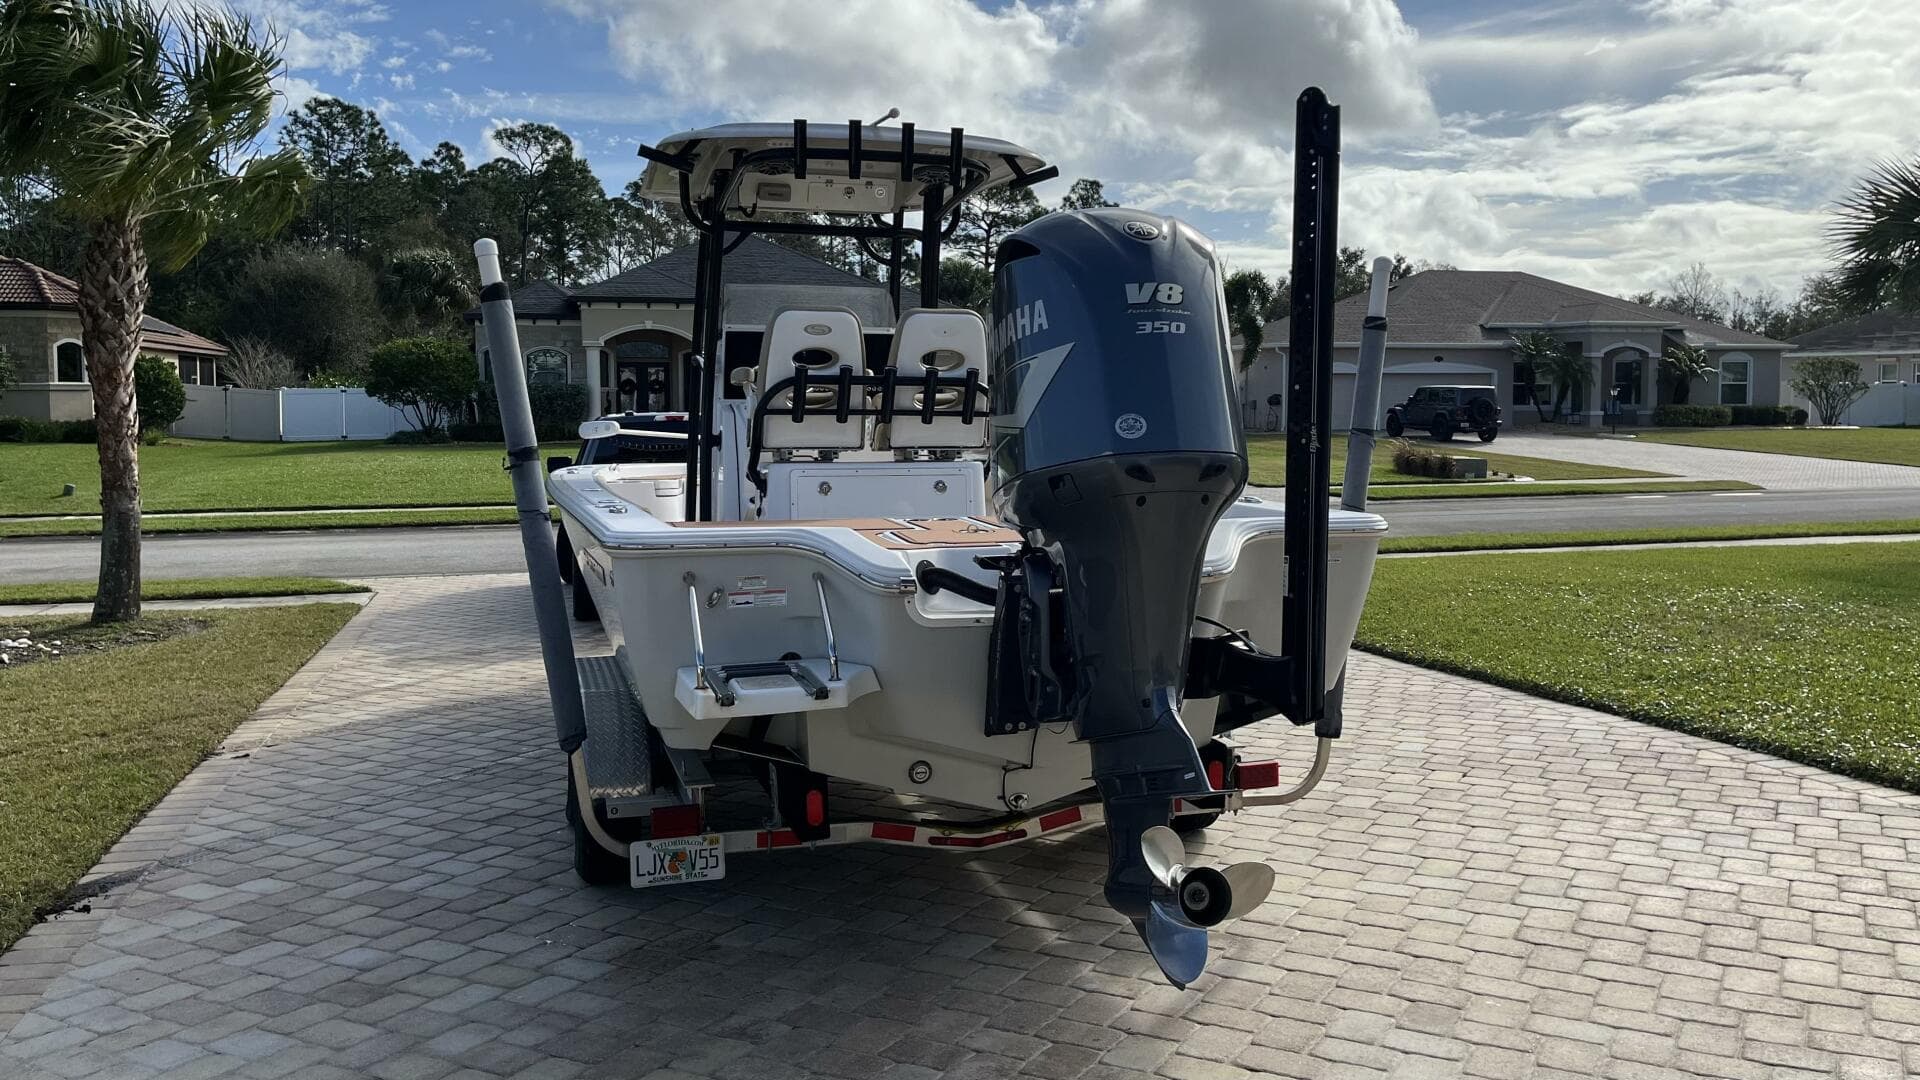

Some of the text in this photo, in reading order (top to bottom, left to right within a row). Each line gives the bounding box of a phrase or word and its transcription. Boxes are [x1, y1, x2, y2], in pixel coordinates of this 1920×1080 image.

[1125, 282, 1184, 305] V8
[994, 299, 1049, 360] AMAHA
[1135, 321, 1186, 334] 350
[636, 847, 719, 877] LJX V55
[652, 872, 705, 882] SUNSHINE STATE
